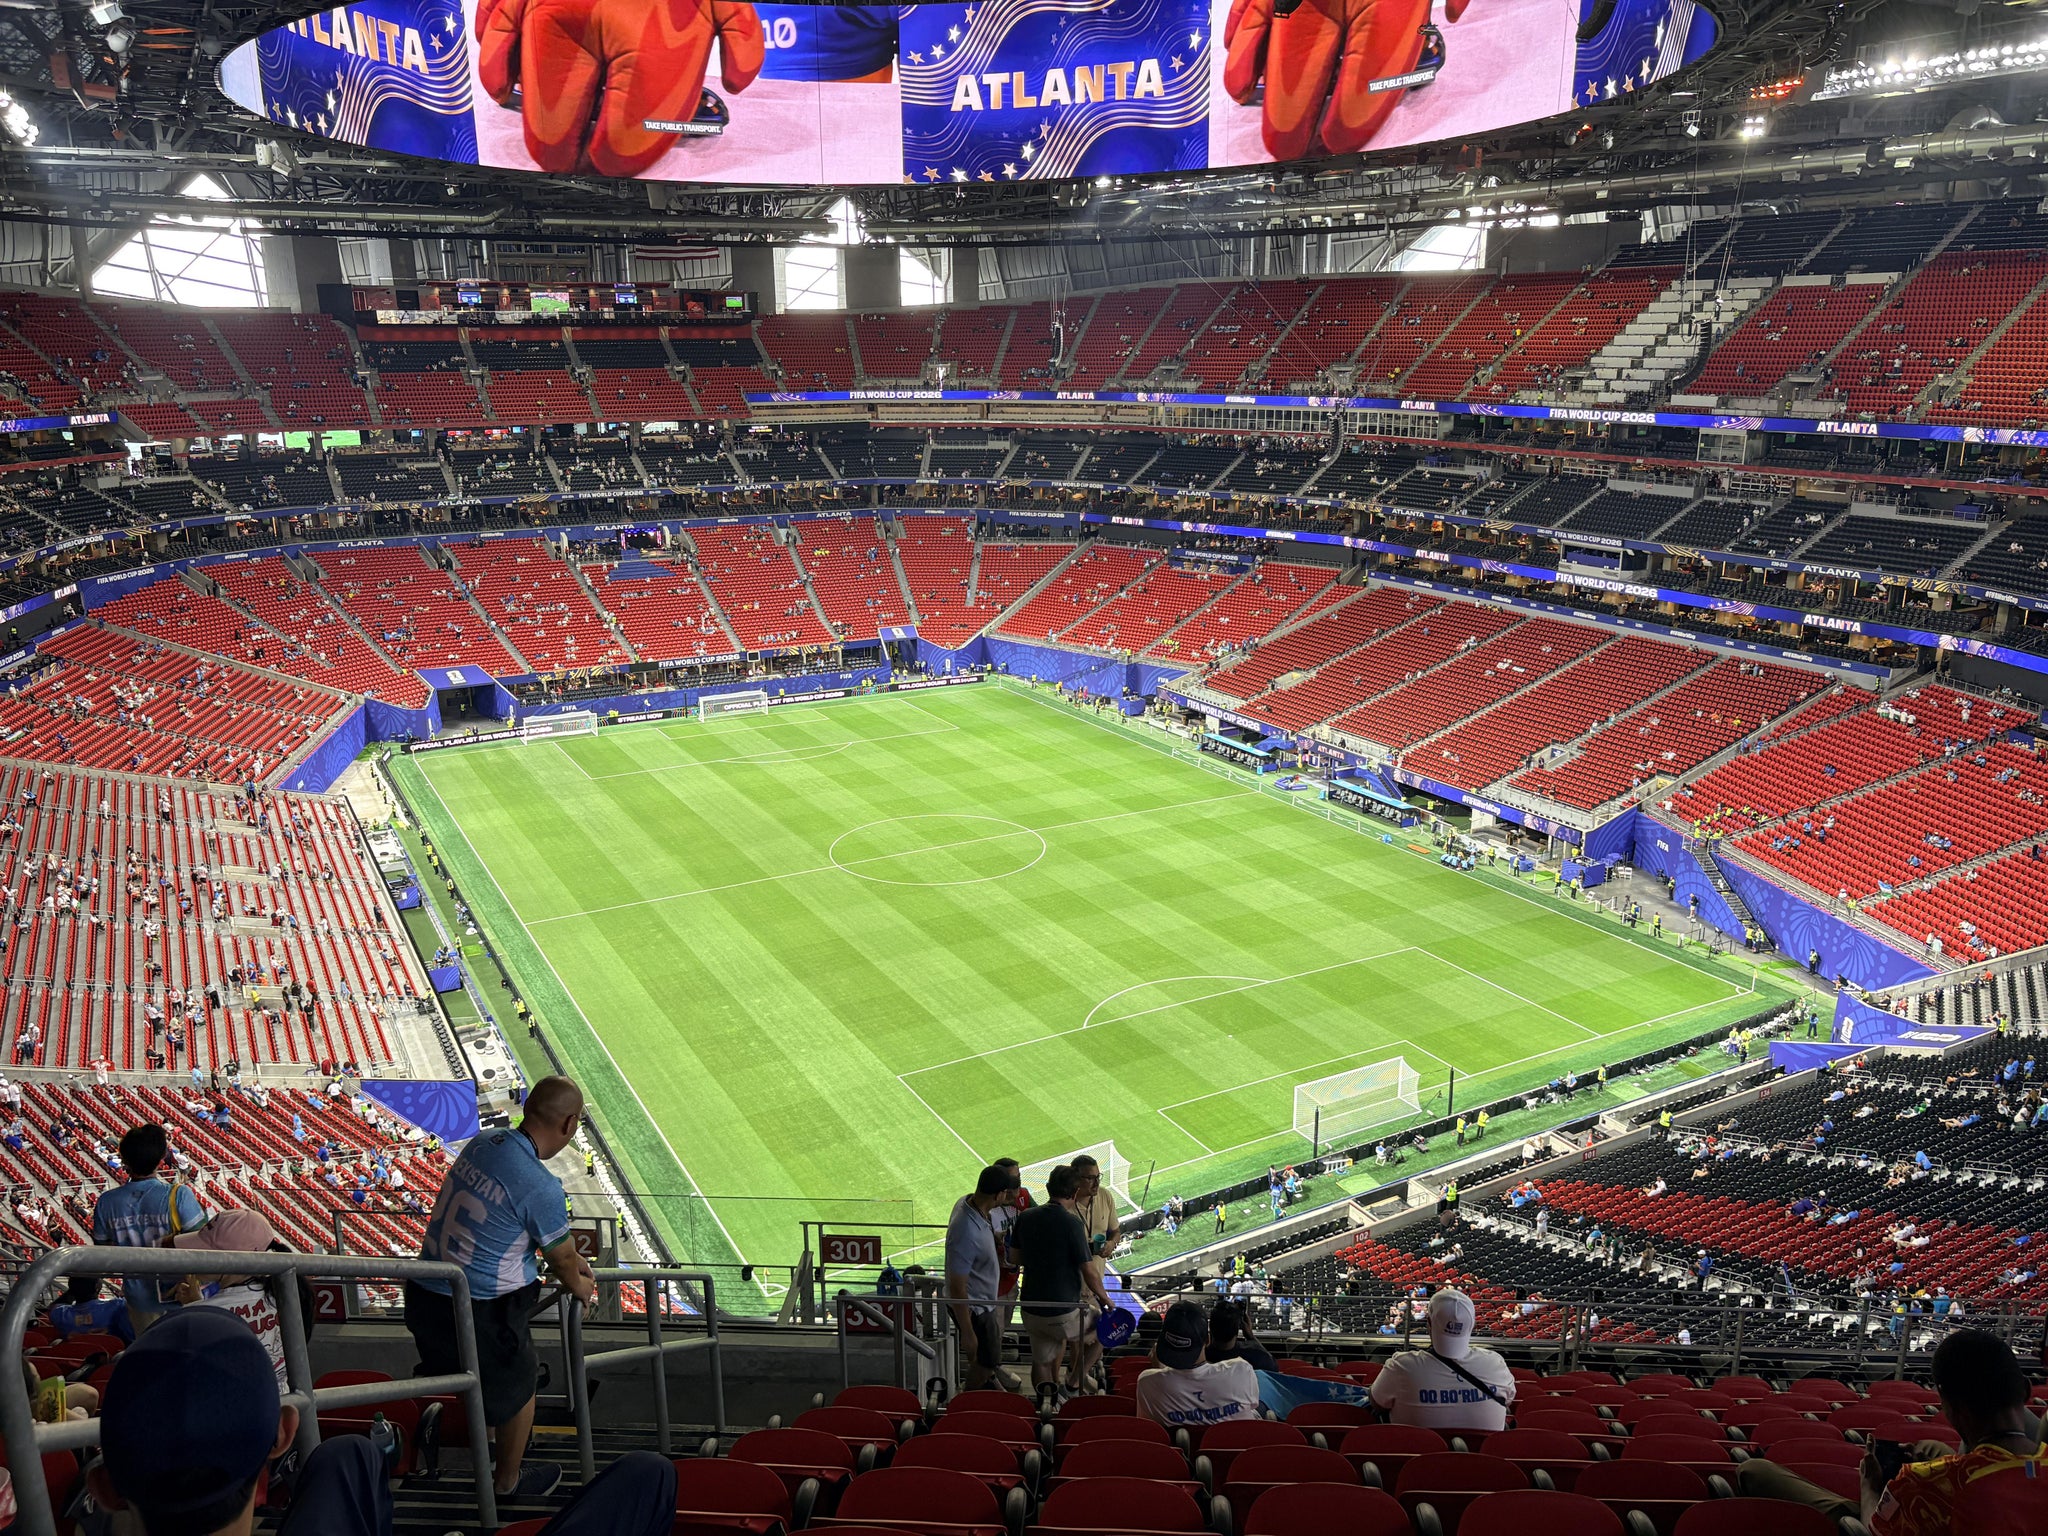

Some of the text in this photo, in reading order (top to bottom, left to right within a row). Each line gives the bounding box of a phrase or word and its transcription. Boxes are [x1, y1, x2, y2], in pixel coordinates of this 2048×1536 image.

[951, 58, 1165, 112] ATLANTA
[1369, 81, 1384, 92] TAKE
[1383, 78, 1403, 89] PUBLIC
[645, 121, 661, 130] TAKE
[661, 122, 683, 131] PUBLIC
[850, 391, 942, 399] FIFA WORLD CUP 2026
[1056, 391, 1094, 400] ATLANTA
[1401, 400, 1435, 411] ATLANTA
[70, 412, 110, 426] ATLANTA
[1550, 408, 1656, 423] FIFA WORLD CUP 2026
[1817, 421, 1878, 435] ATLANTA
[438, 499, 482, 507] ATLANTA
[1392, 508, 1425, 518] ATLANTA
[1111, 516, 1144, 526] ATLANTA
[75, 538, 85, 546] CUP
[85, 534, 104, 544] 2026
[338, 540, 385, 548] ATLANTA
[1567, 532, 1588, 541] WORLD
[1588, 534, 1600, 543] CUP
[1600, 537, 1622, 547] 2026
[1415, 549, 1449, 562] ATLANTA
[97, 577, 109, 585] FIFA
[108, 574, 128, 584] WORLD
[138, 568, 155, 577] 2026
[1803, 564, 1861, 579] ATLANTA
[54, 583, 78, 600] ATLANTA
[1556, 572, 1658, 598] FIFA WORLD CUP 2026
[1804, 614, 1861, 633] ATLANTA
[13, 650, 26, 661] 2026
[659, 654, 740, 668] FIFA WORLD CUP 2026
[1158, 676, 1168, 684] FIFA
[562, 704, 577, 712] FIFA
[618, 712, 663, 724] STREAM NOW
[1186, 700, 1260, 732] FIFA WORLD CUP 2026
[410, 742, 444, 751] OFFICIAL
[444, 737, 477, 746] PLAYLIST
[479, 734, 492, 742] FIFA
[492, 730, 516, 740] WORLD
[1318, 746, 1344, 760] ATLANTA
[1656, 839, 1669, 853] FIFA
[1584, 1149, 1596, 1161] 101
[454, 1158, 506, 1206] EKISTAN
[1355, 1231, 1369, 1243] 102
[830, 1240, 875, 1262] 301
[1107, 1322, 1128, 1341] ULTRA
